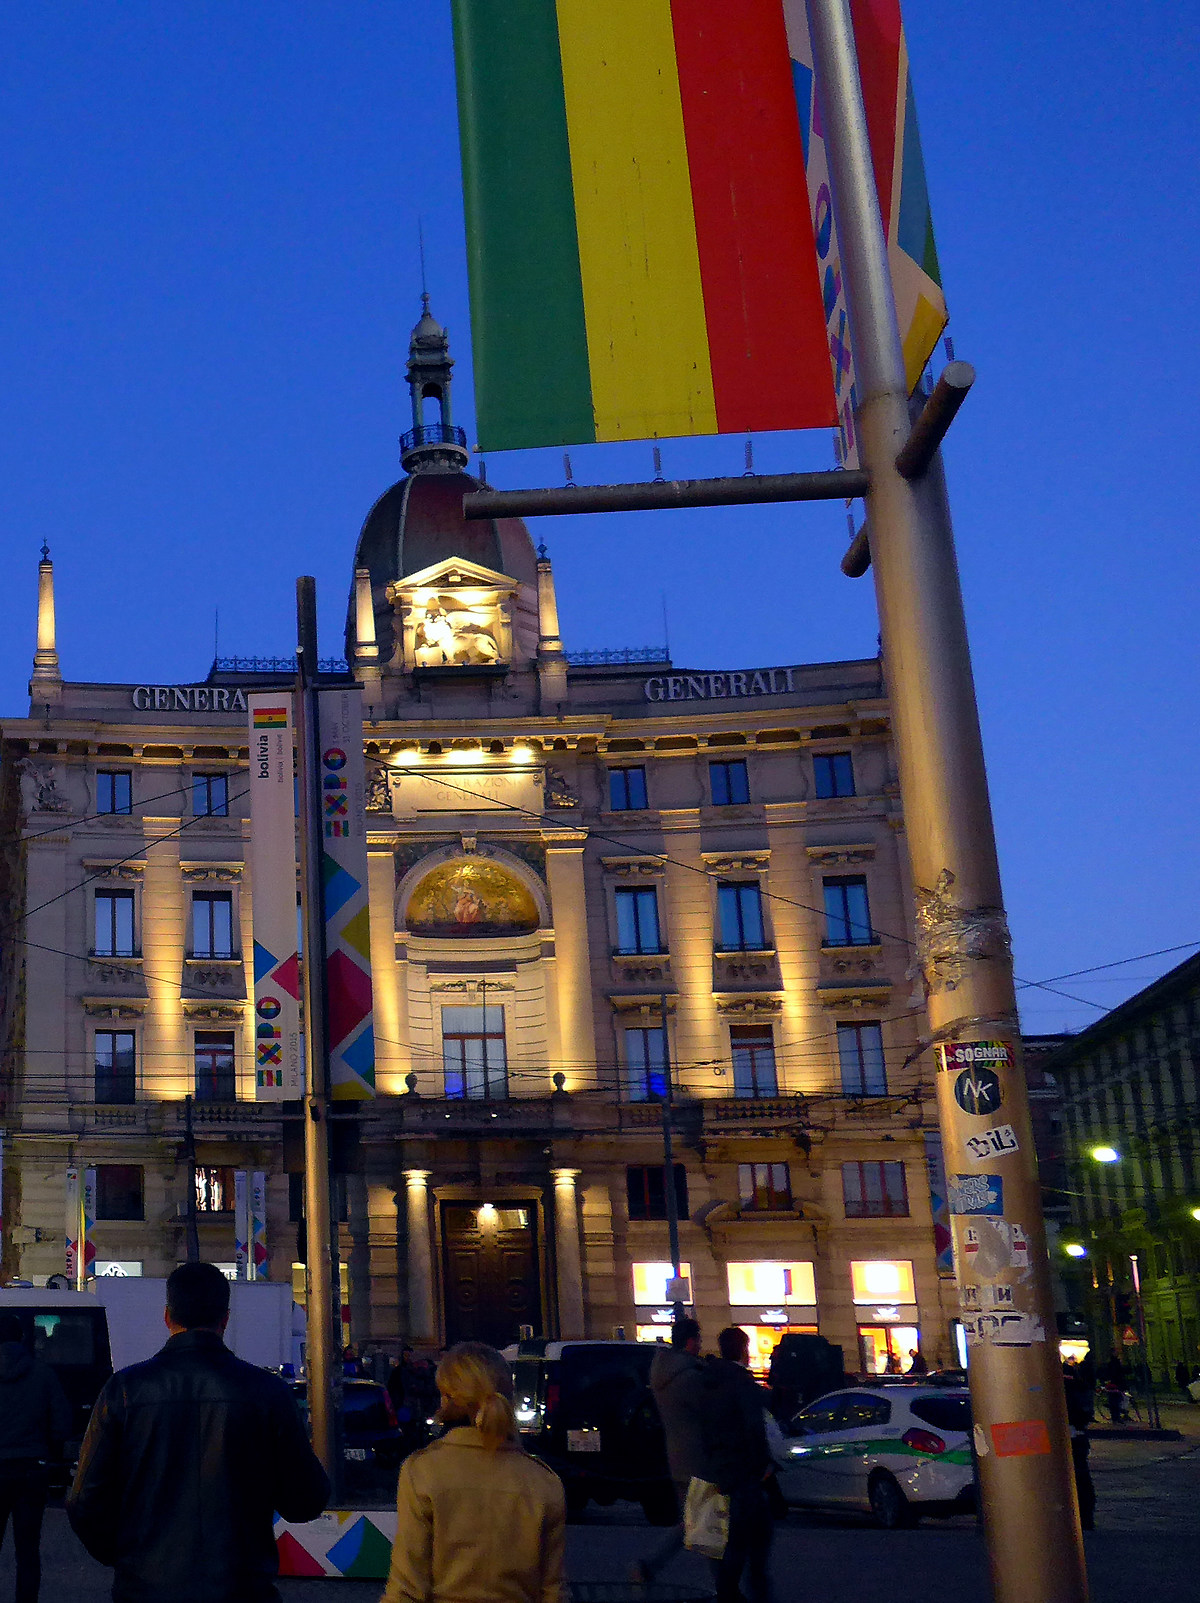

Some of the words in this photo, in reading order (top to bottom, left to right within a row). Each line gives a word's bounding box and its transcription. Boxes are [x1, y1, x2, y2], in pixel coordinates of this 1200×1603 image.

[815, 182, 857, 462] EXPO
[132, 686, 248, 711] GENERA
[644, 669, 795, 702] GENERALI
[257, 735, 270, 779] bolivia
[322, 748, 349, 839] EXPO
[256, 996, 282, 1087] EXPO
[289, 1032, 298, 1052] 2015
[963, 1077, 994, 1101] NK
[65, 1250, 73, 1276] EXPO
